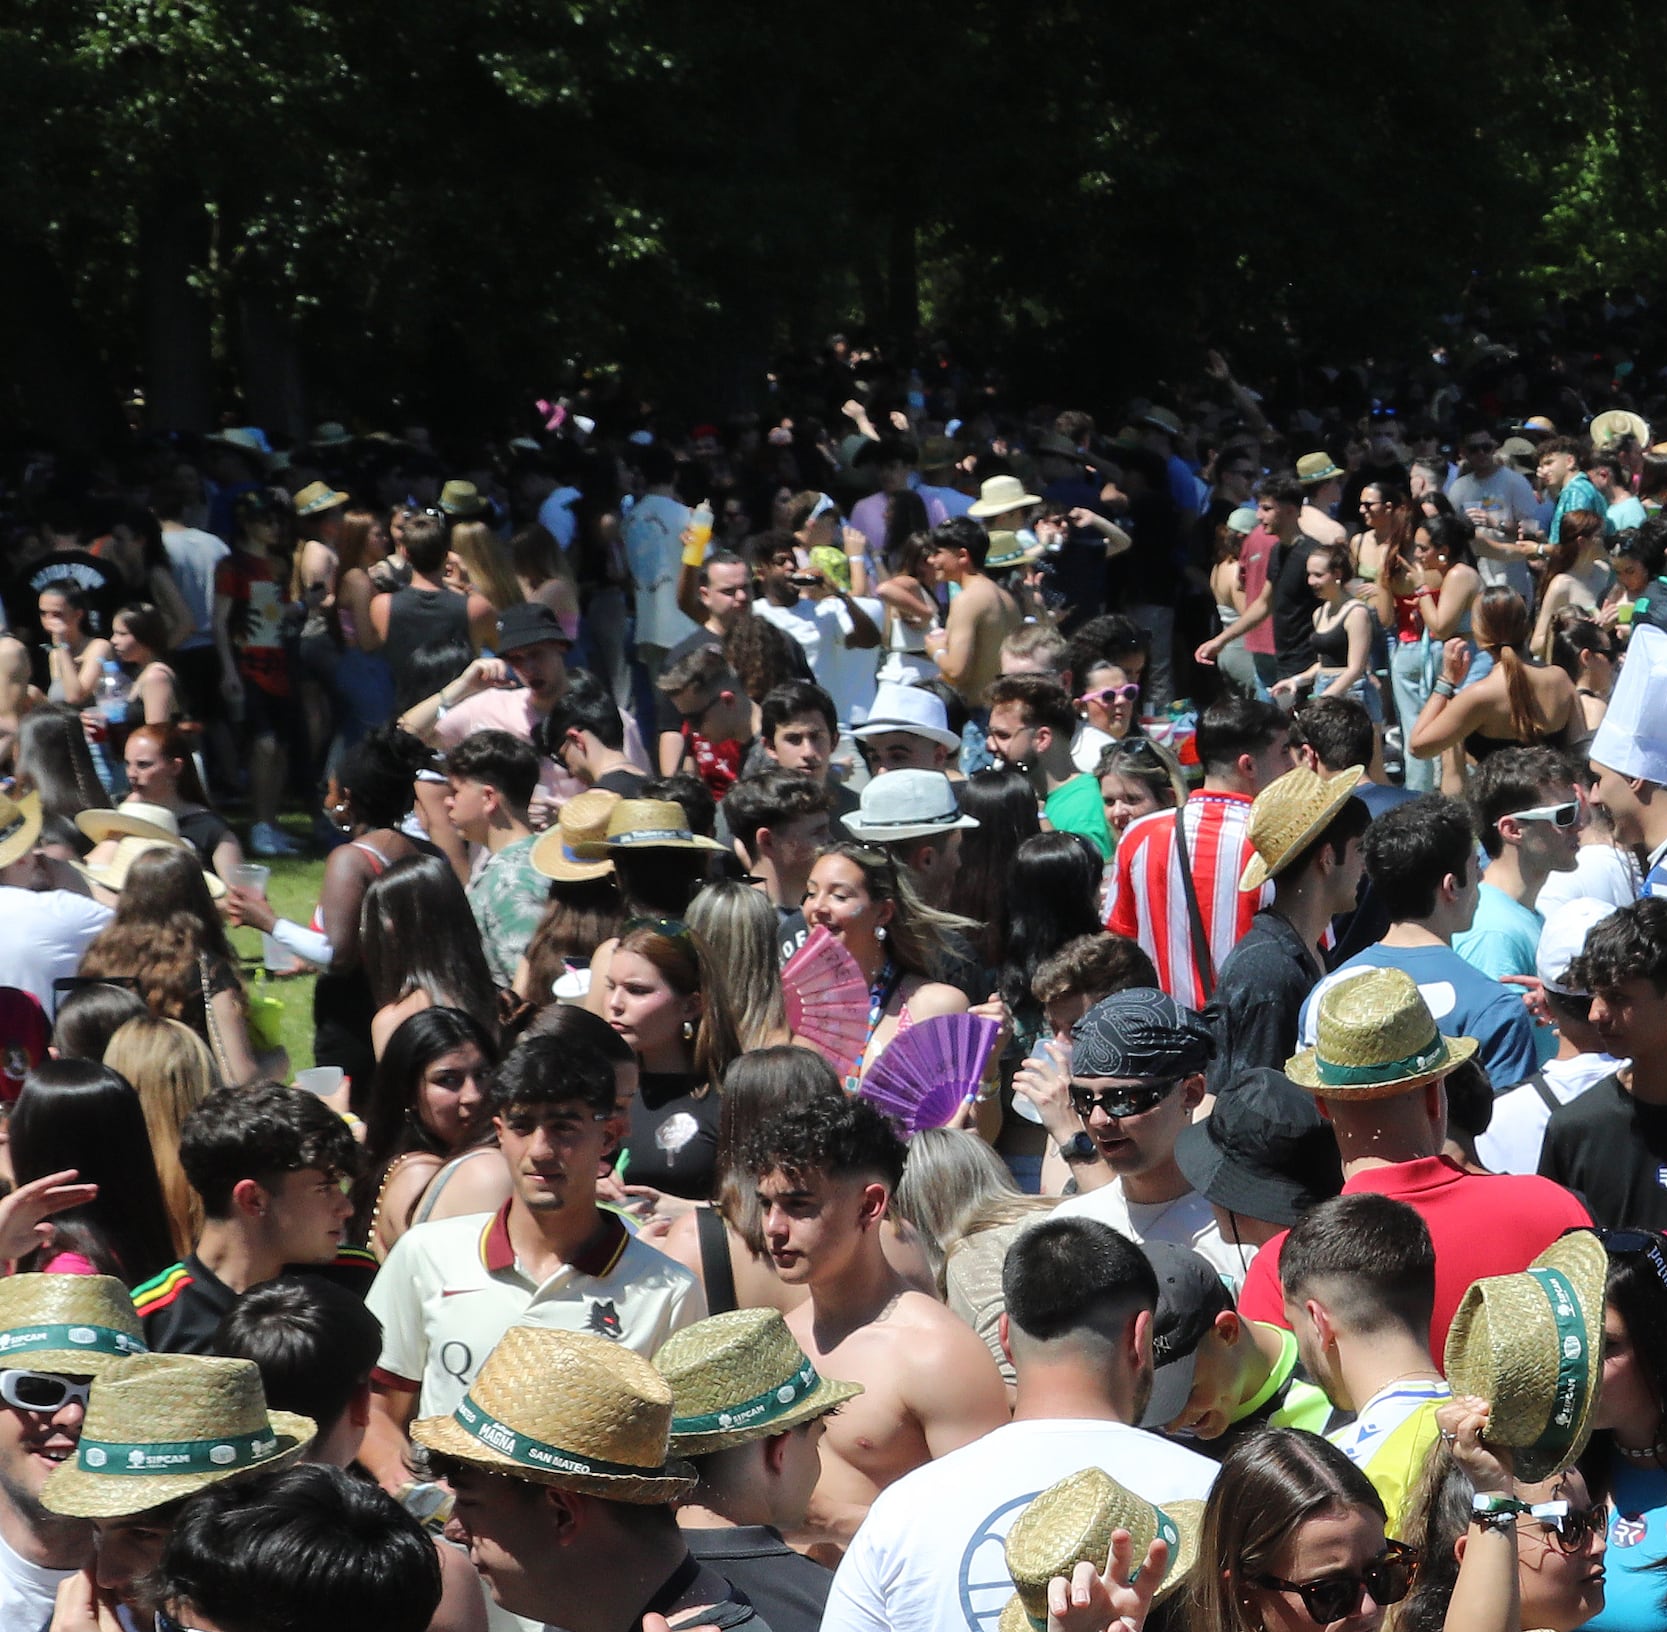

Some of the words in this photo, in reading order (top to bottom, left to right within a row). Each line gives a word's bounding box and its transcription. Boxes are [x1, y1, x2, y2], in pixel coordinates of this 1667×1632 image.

[9, 1331, 48, 1343] SIPCAM
[441, 1341, 472, 1385] Q
[731, 1404, 766, 1424] SIPCAM
[477, 1423, 517, 1453] MAGNA
[145, 1453, 190, 1465] SIPCAM
[528, 1447, 552, 1465] SAN
[552, 1455, 591, 1474] MATEO
